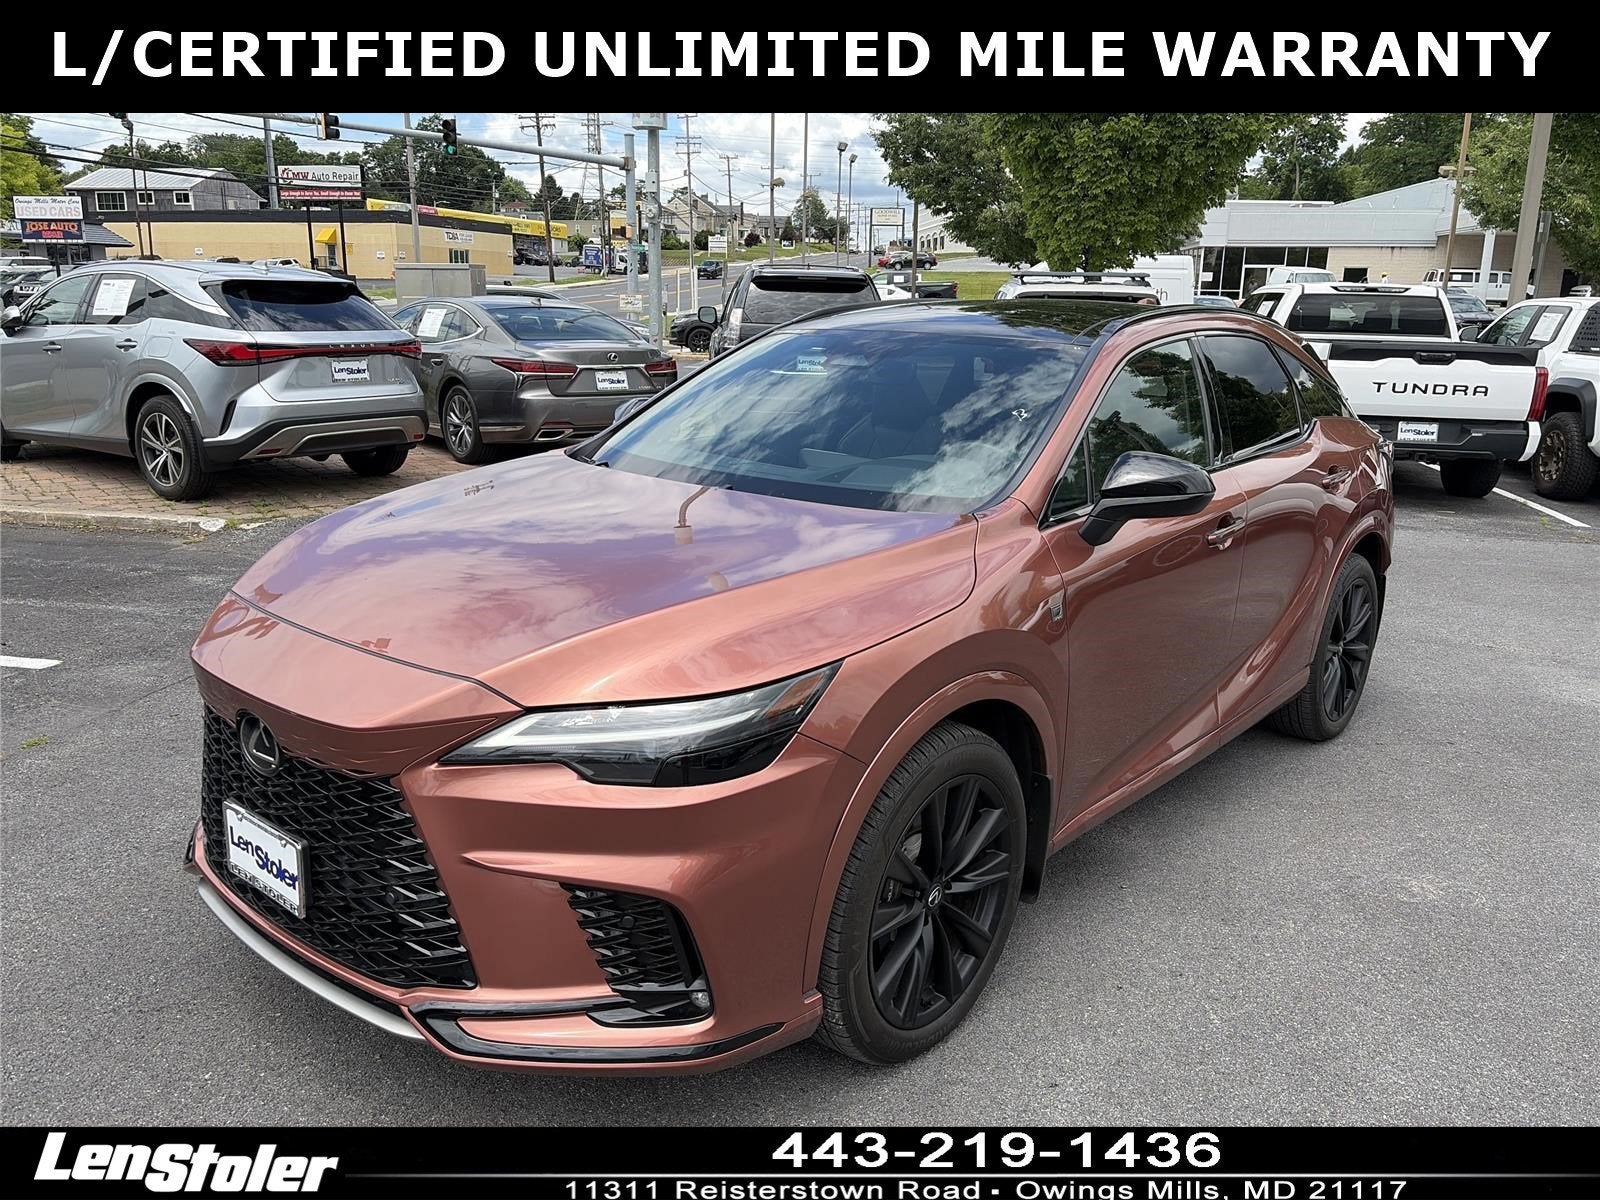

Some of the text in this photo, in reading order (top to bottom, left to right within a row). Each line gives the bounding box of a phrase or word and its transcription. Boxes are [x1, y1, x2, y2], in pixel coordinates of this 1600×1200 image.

[311, 171, 330, 181] Auto
[332, 171, 359, 182] Repair
[16, 206, 81, 217] USED CARS
[25, 221, 79, 231] JOSE AUTO
[1372, 381, 1489, 397] TUNDRA
[229, 825, 299, 891] LenStoler
